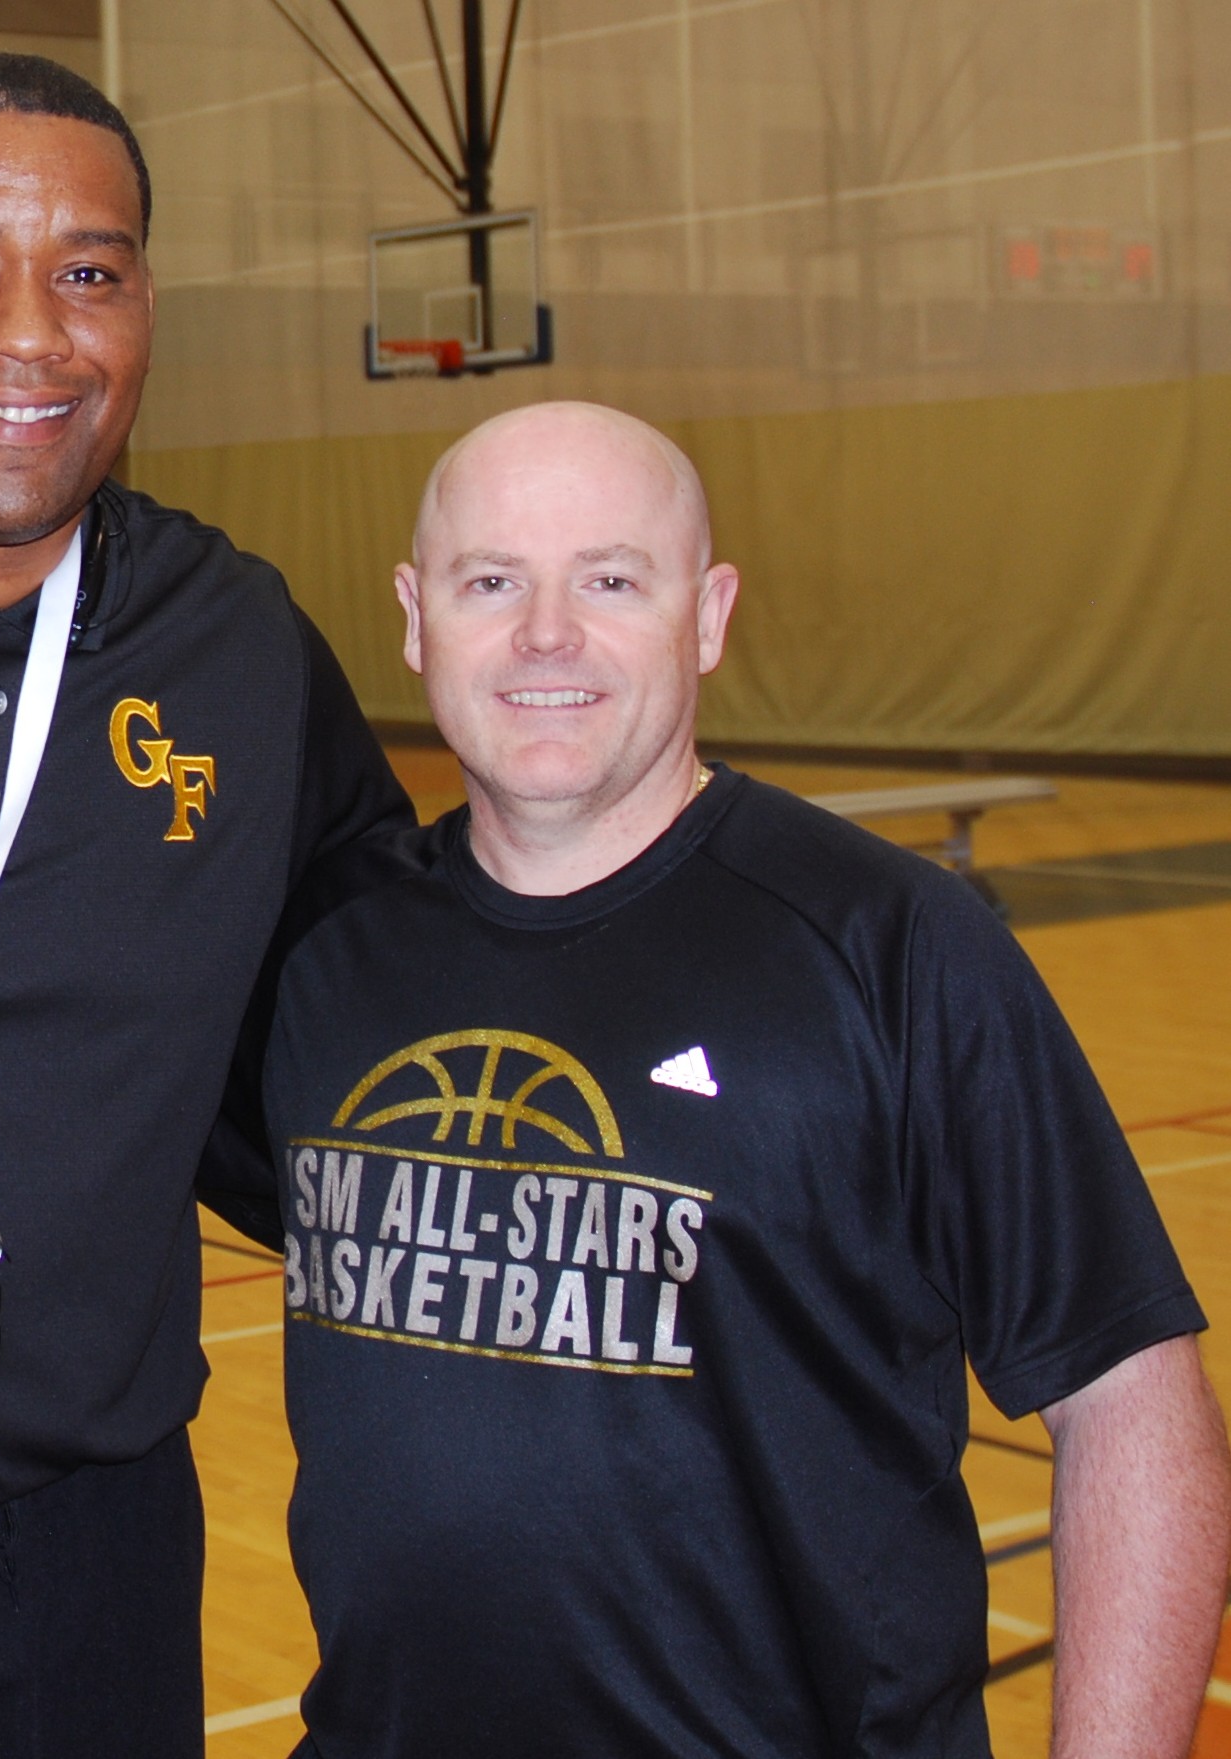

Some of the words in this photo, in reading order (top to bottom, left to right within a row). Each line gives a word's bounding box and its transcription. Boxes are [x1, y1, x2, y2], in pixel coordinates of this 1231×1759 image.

[109, 697, 216, 841] GF
[379, 1160, 703, 1283] ALL-STARS
[284, 1231, 694, 1365] BASKETBALL
